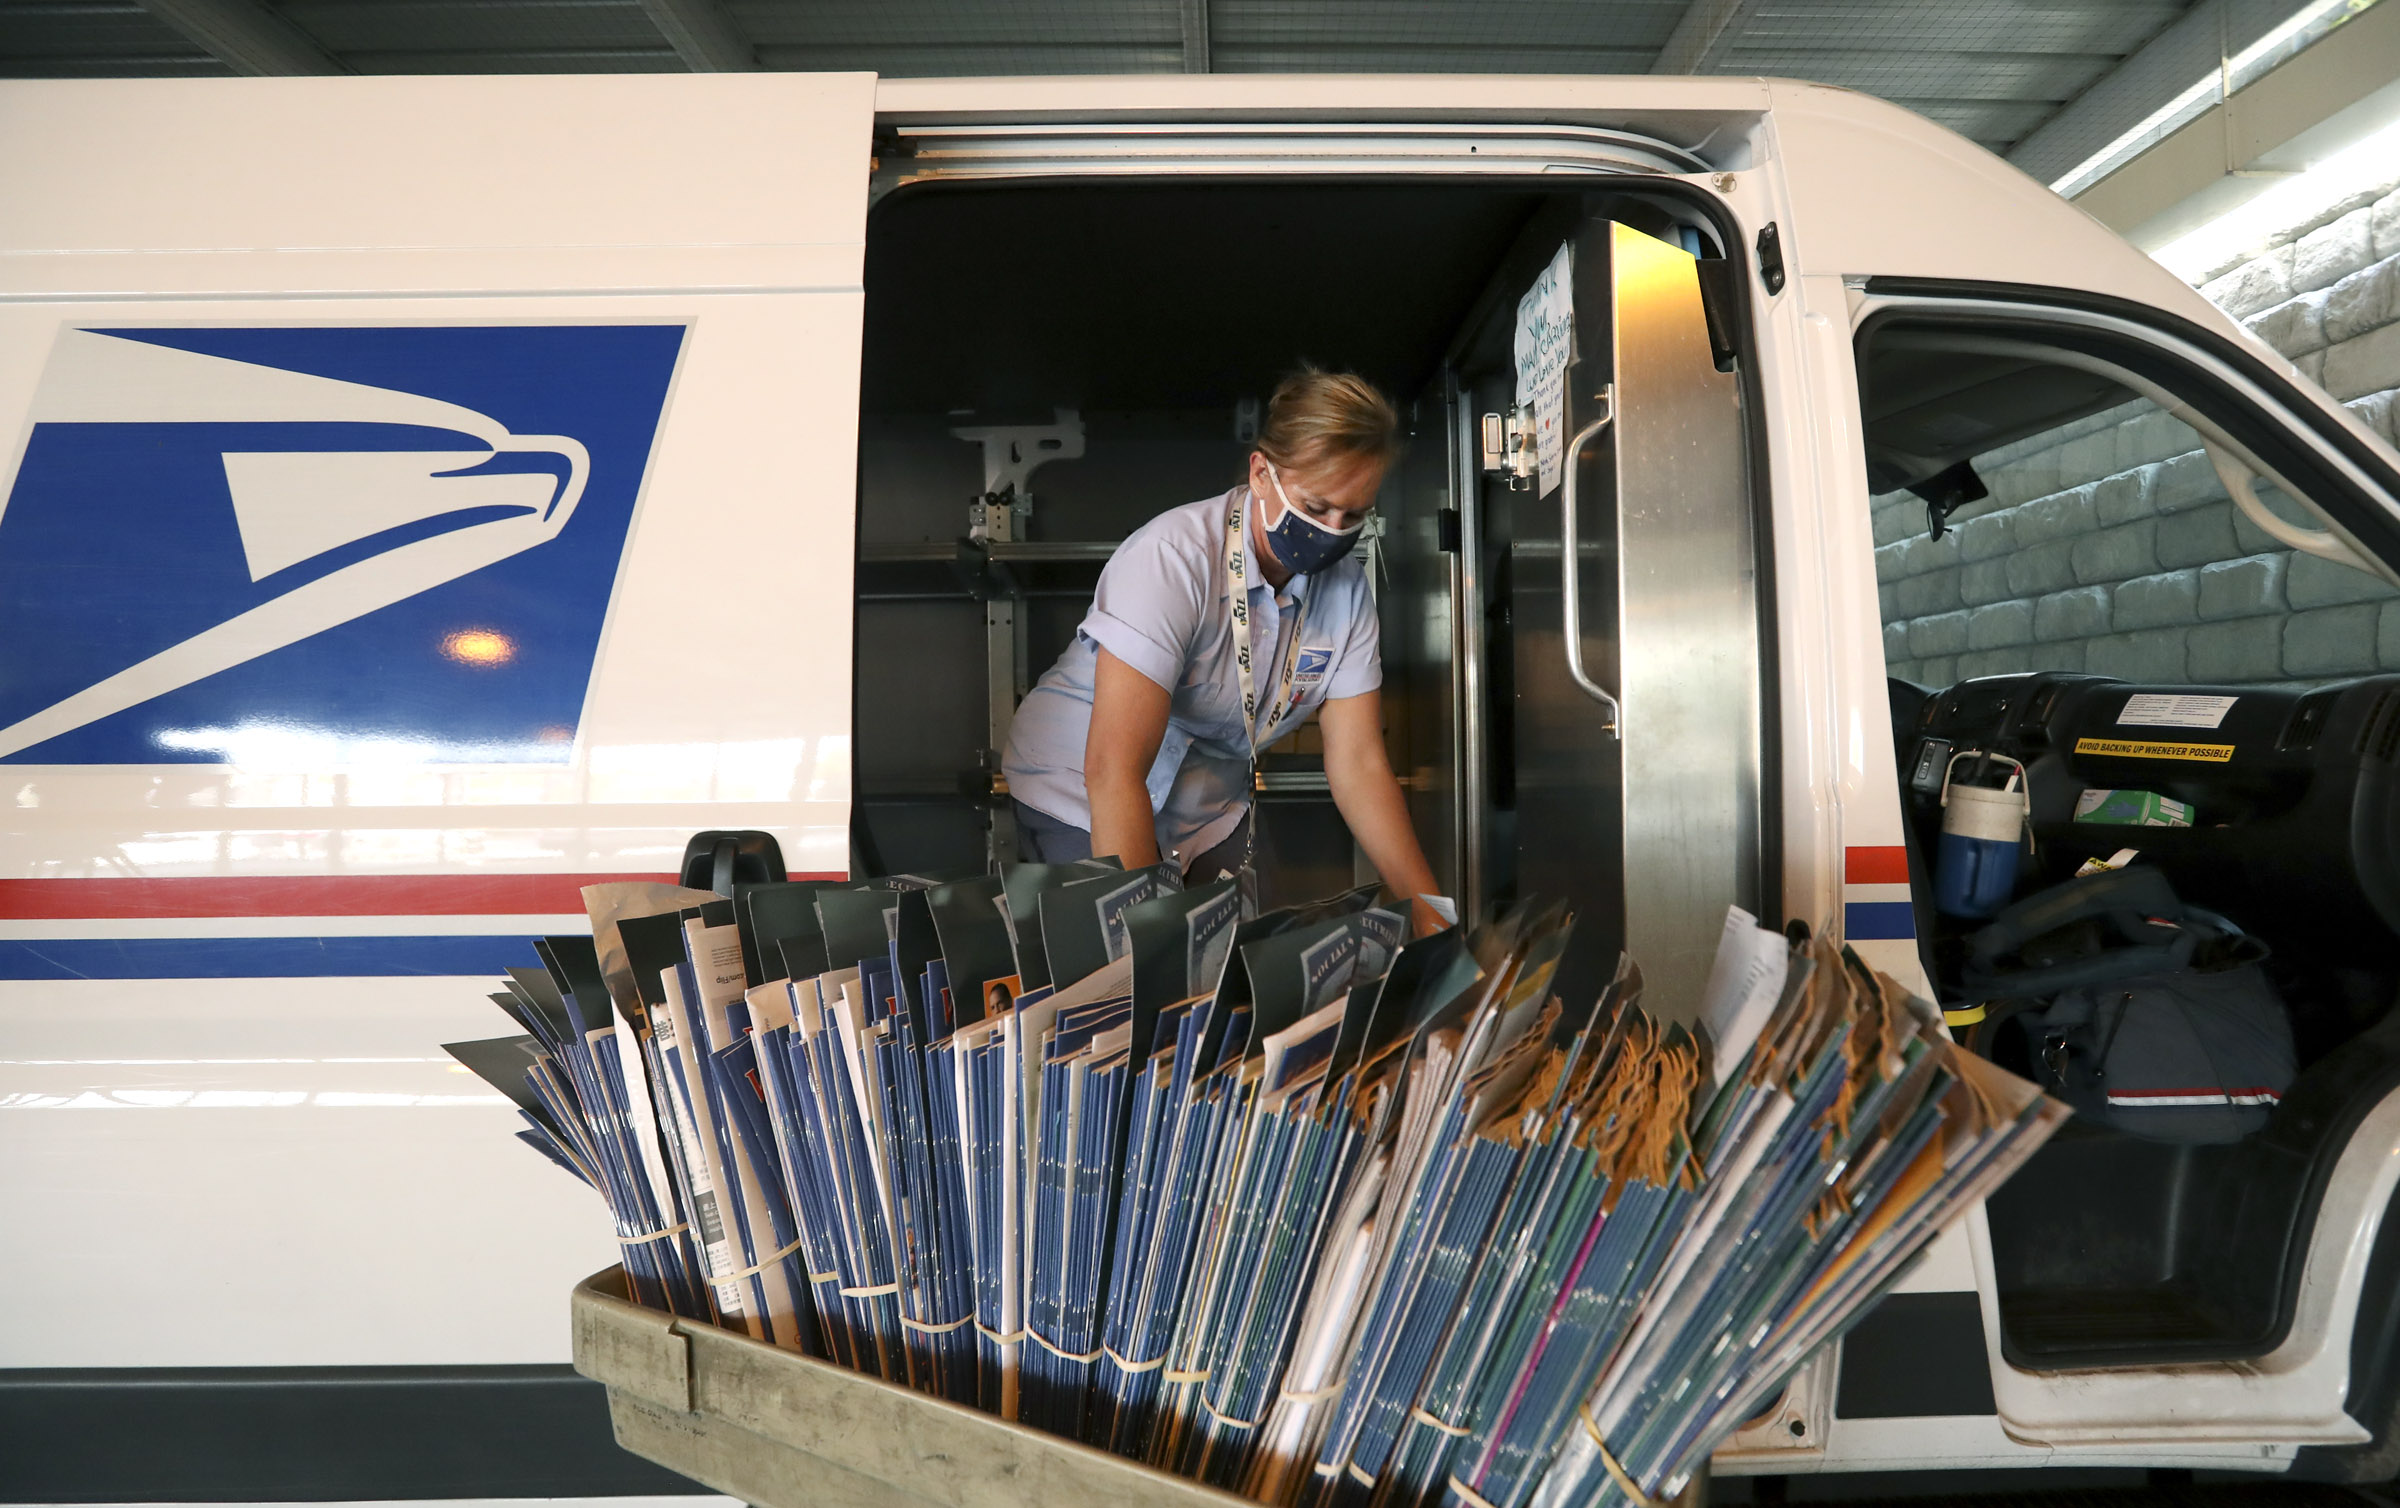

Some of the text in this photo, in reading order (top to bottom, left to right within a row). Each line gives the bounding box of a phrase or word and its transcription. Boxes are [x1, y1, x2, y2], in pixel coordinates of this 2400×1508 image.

[2078, 741, 2231, 759] AVOID BACKING UP WHENEVER POSSIBLE
